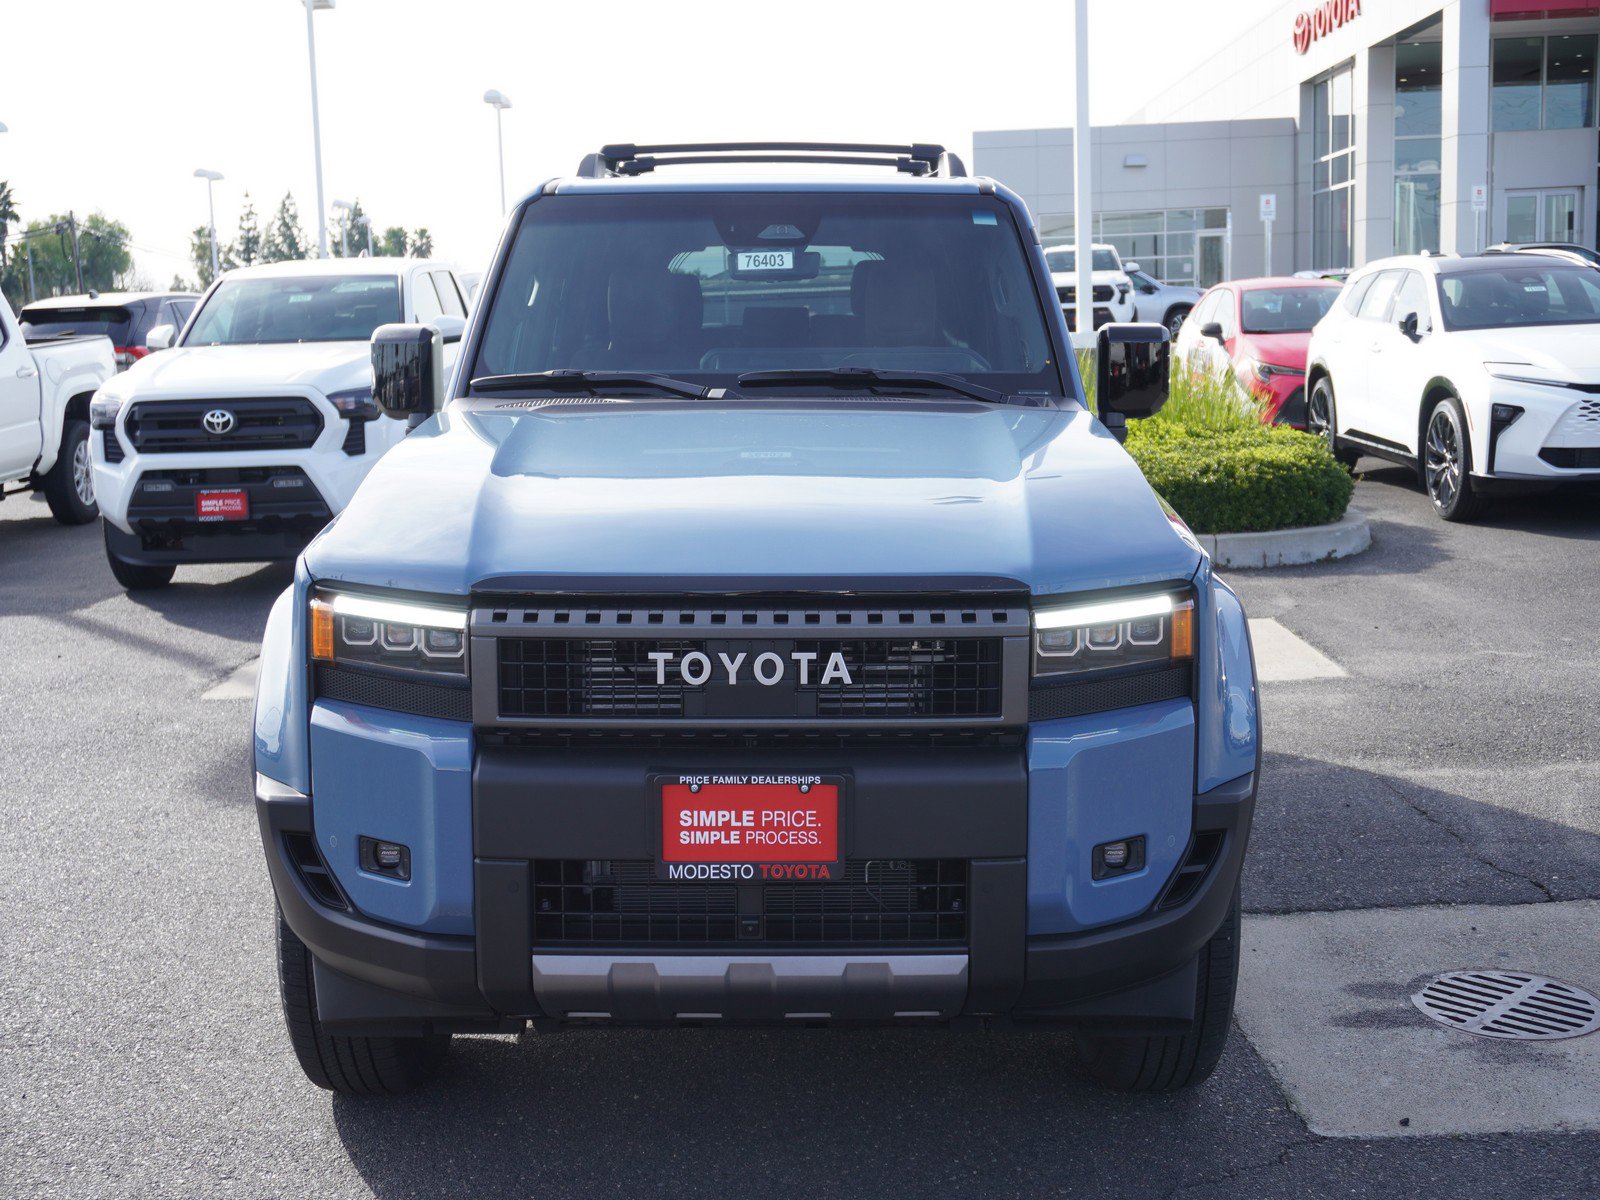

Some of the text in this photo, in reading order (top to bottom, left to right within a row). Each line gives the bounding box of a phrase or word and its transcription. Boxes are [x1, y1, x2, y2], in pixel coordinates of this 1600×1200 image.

[1313, 0, 1361, 42] TOYOTA
[745, 253, 785, 268] 76403
[648, 651, 852, 686] TOYOTA
[679, 776, 821, 784] PRICE FAMILY DEALERSHIPS
[679, 810, 822, 827] SIMPLE PRICE.
[679, 831, 822, 845] SIMPLE PROCESS.
[669, 864, 830, 879] MODESTO TOYOTA
